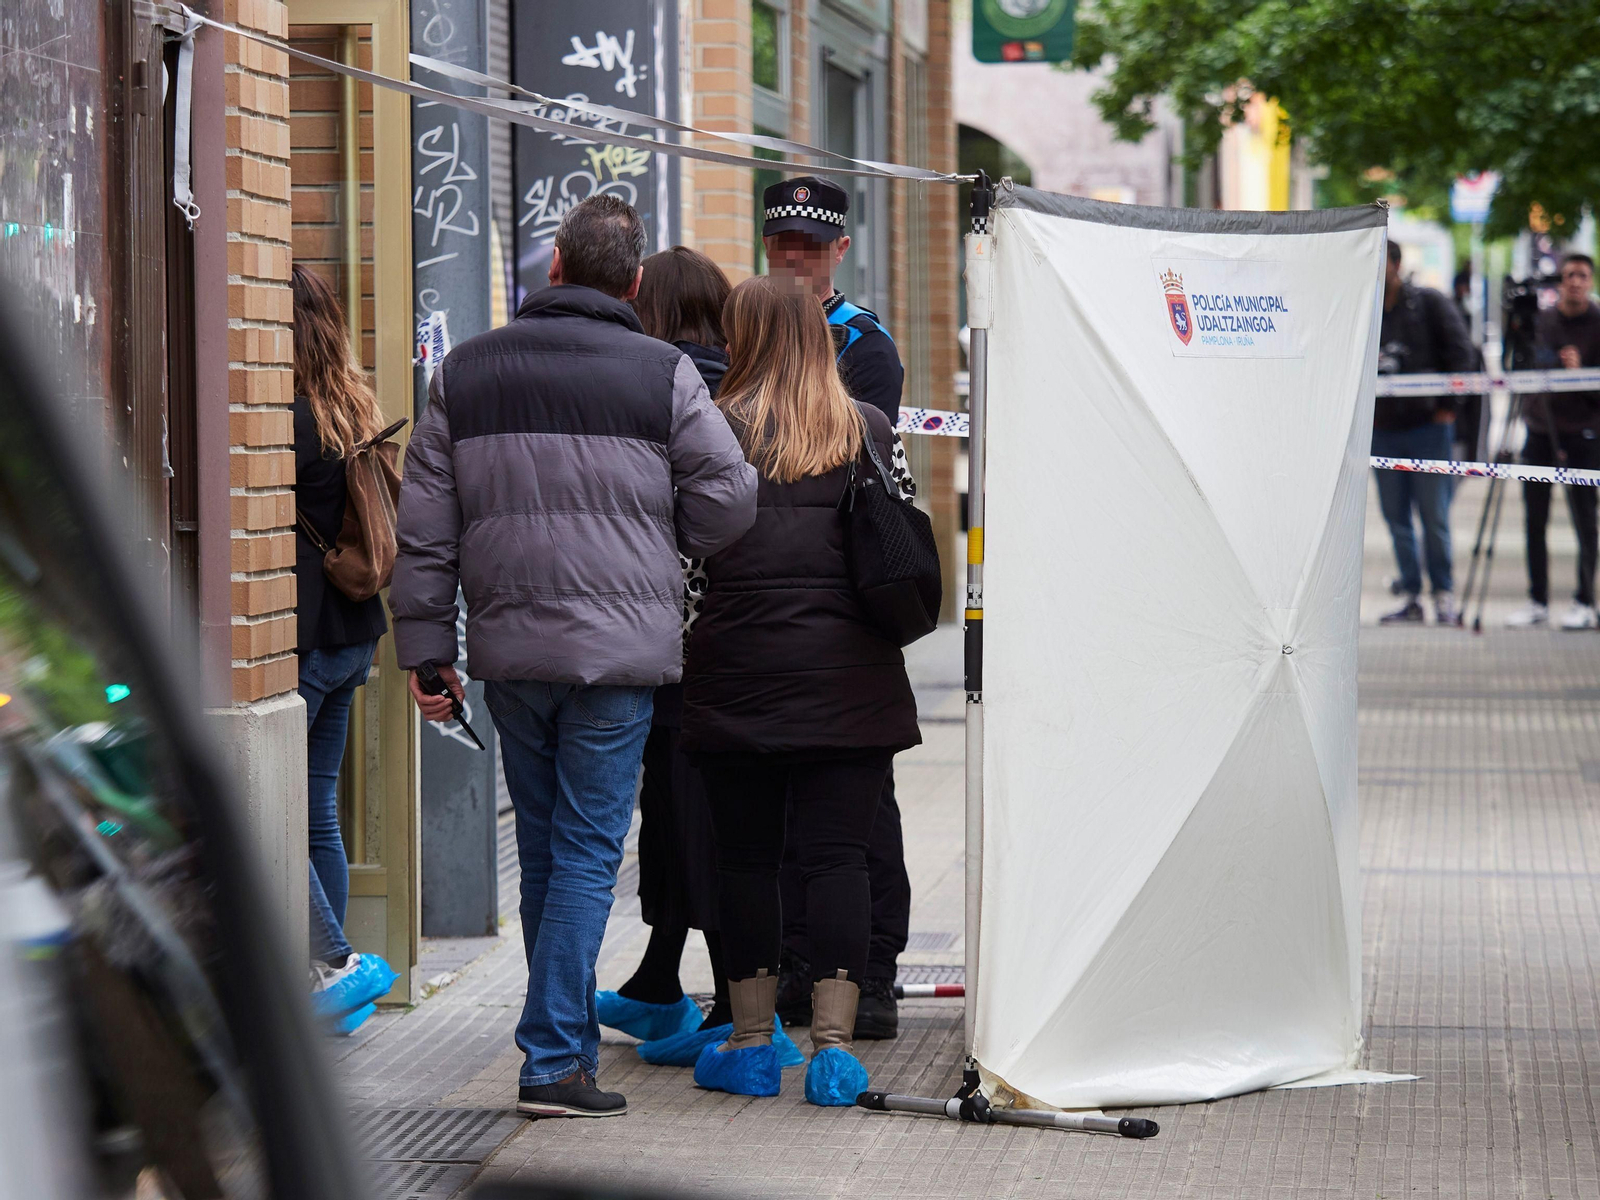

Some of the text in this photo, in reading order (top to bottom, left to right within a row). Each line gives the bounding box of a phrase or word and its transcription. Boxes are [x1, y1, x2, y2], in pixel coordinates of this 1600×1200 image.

[1192, 294, 1288, 312] POLICÍA MUNICIPAL
[1196, 315, 1276, 333] UDALTZAINGOA
[1201, 335, 1233, 346] PAMPLONA
